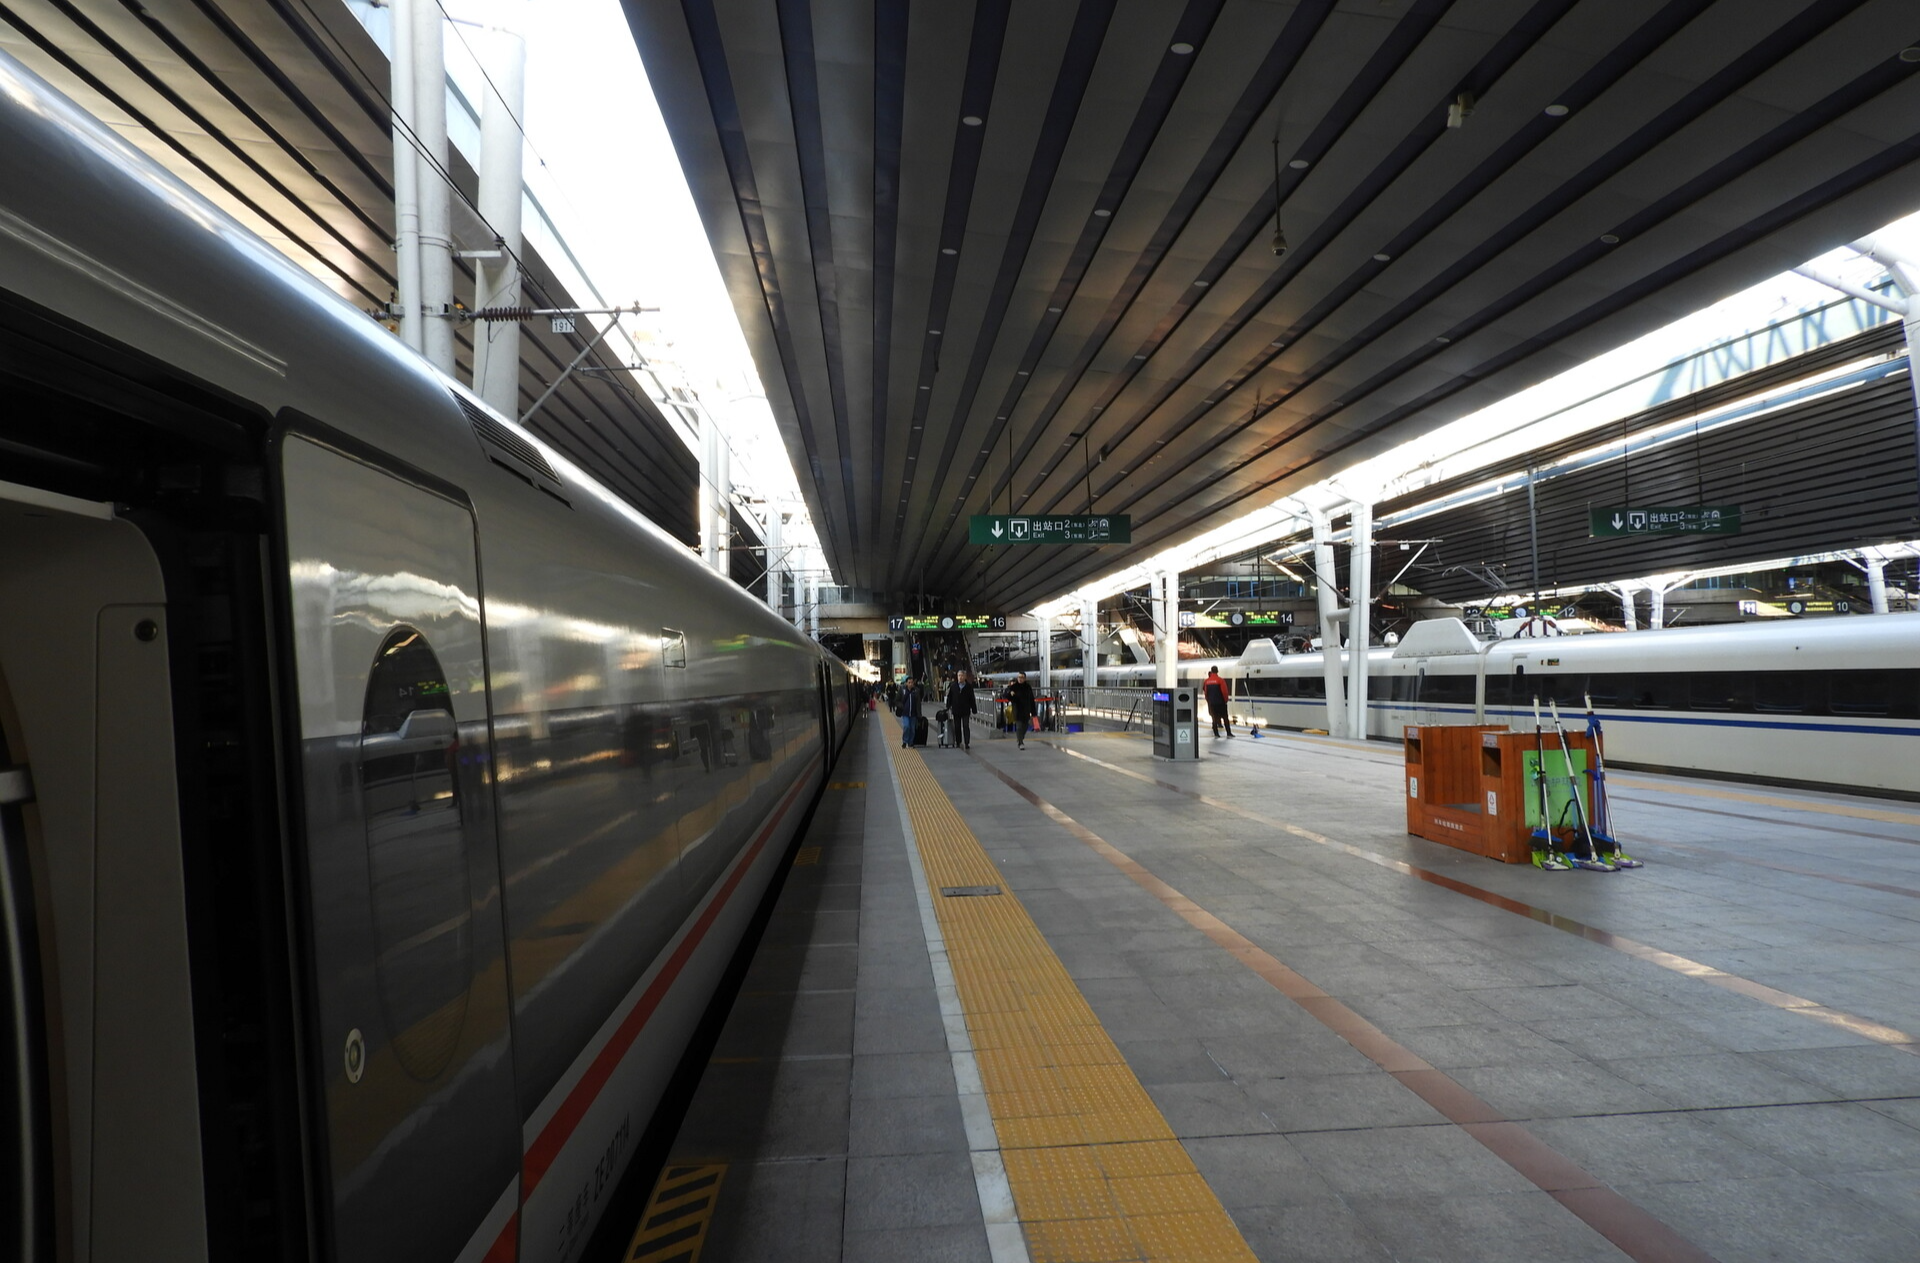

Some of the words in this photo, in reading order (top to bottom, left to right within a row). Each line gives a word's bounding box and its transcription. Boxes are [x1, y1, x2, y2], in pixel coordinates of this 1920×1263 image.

[1650, 513, 1678, 522] 出站口
[1679, 511, 1685, 519] 2
[1032, 520, 1063, 531] 出站口
[1064, 519, 1071, 528] 2
[1064, 530, 1071, 539] 3
[1836, 601, 1849, 612] 10
[1564, 607, 1575, 618] 12
[890, 618, 903, 629] 17
[992, 616, 1005, 628] 16
[1280, 613, 1293, 624] 14
